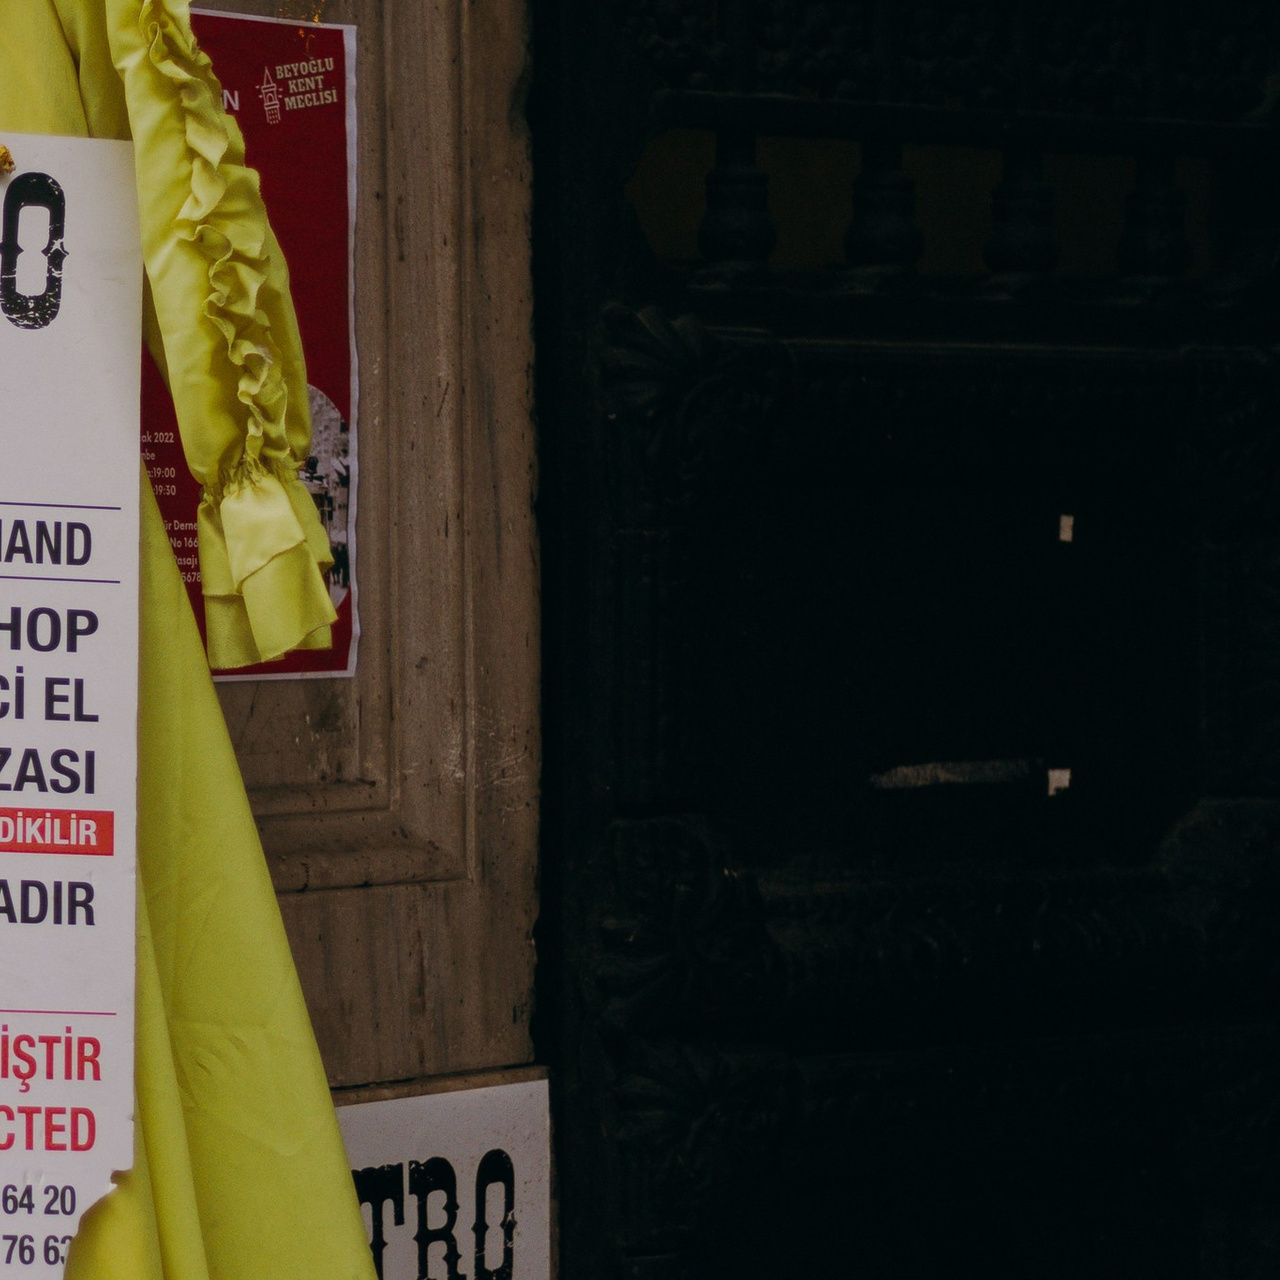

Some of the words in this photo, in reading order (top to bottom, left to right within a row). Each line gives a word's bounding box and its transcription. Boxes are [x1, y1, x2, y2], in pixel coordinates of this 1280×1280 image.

[275, 57, 335, 79] BEYOĞLU
[288, 75, 324, 94] KENT
[284, 86, 338, 111] MECLİSİ
[140, 432, 152, 443] ak
[154, 432, 174, 443] 2022
[44, 677, 99, 723] EL
[1, 1184, 35, 1215] 64
[43, 1185, 77, 1216] 20
[2, 1234, 35, 1265] 76
